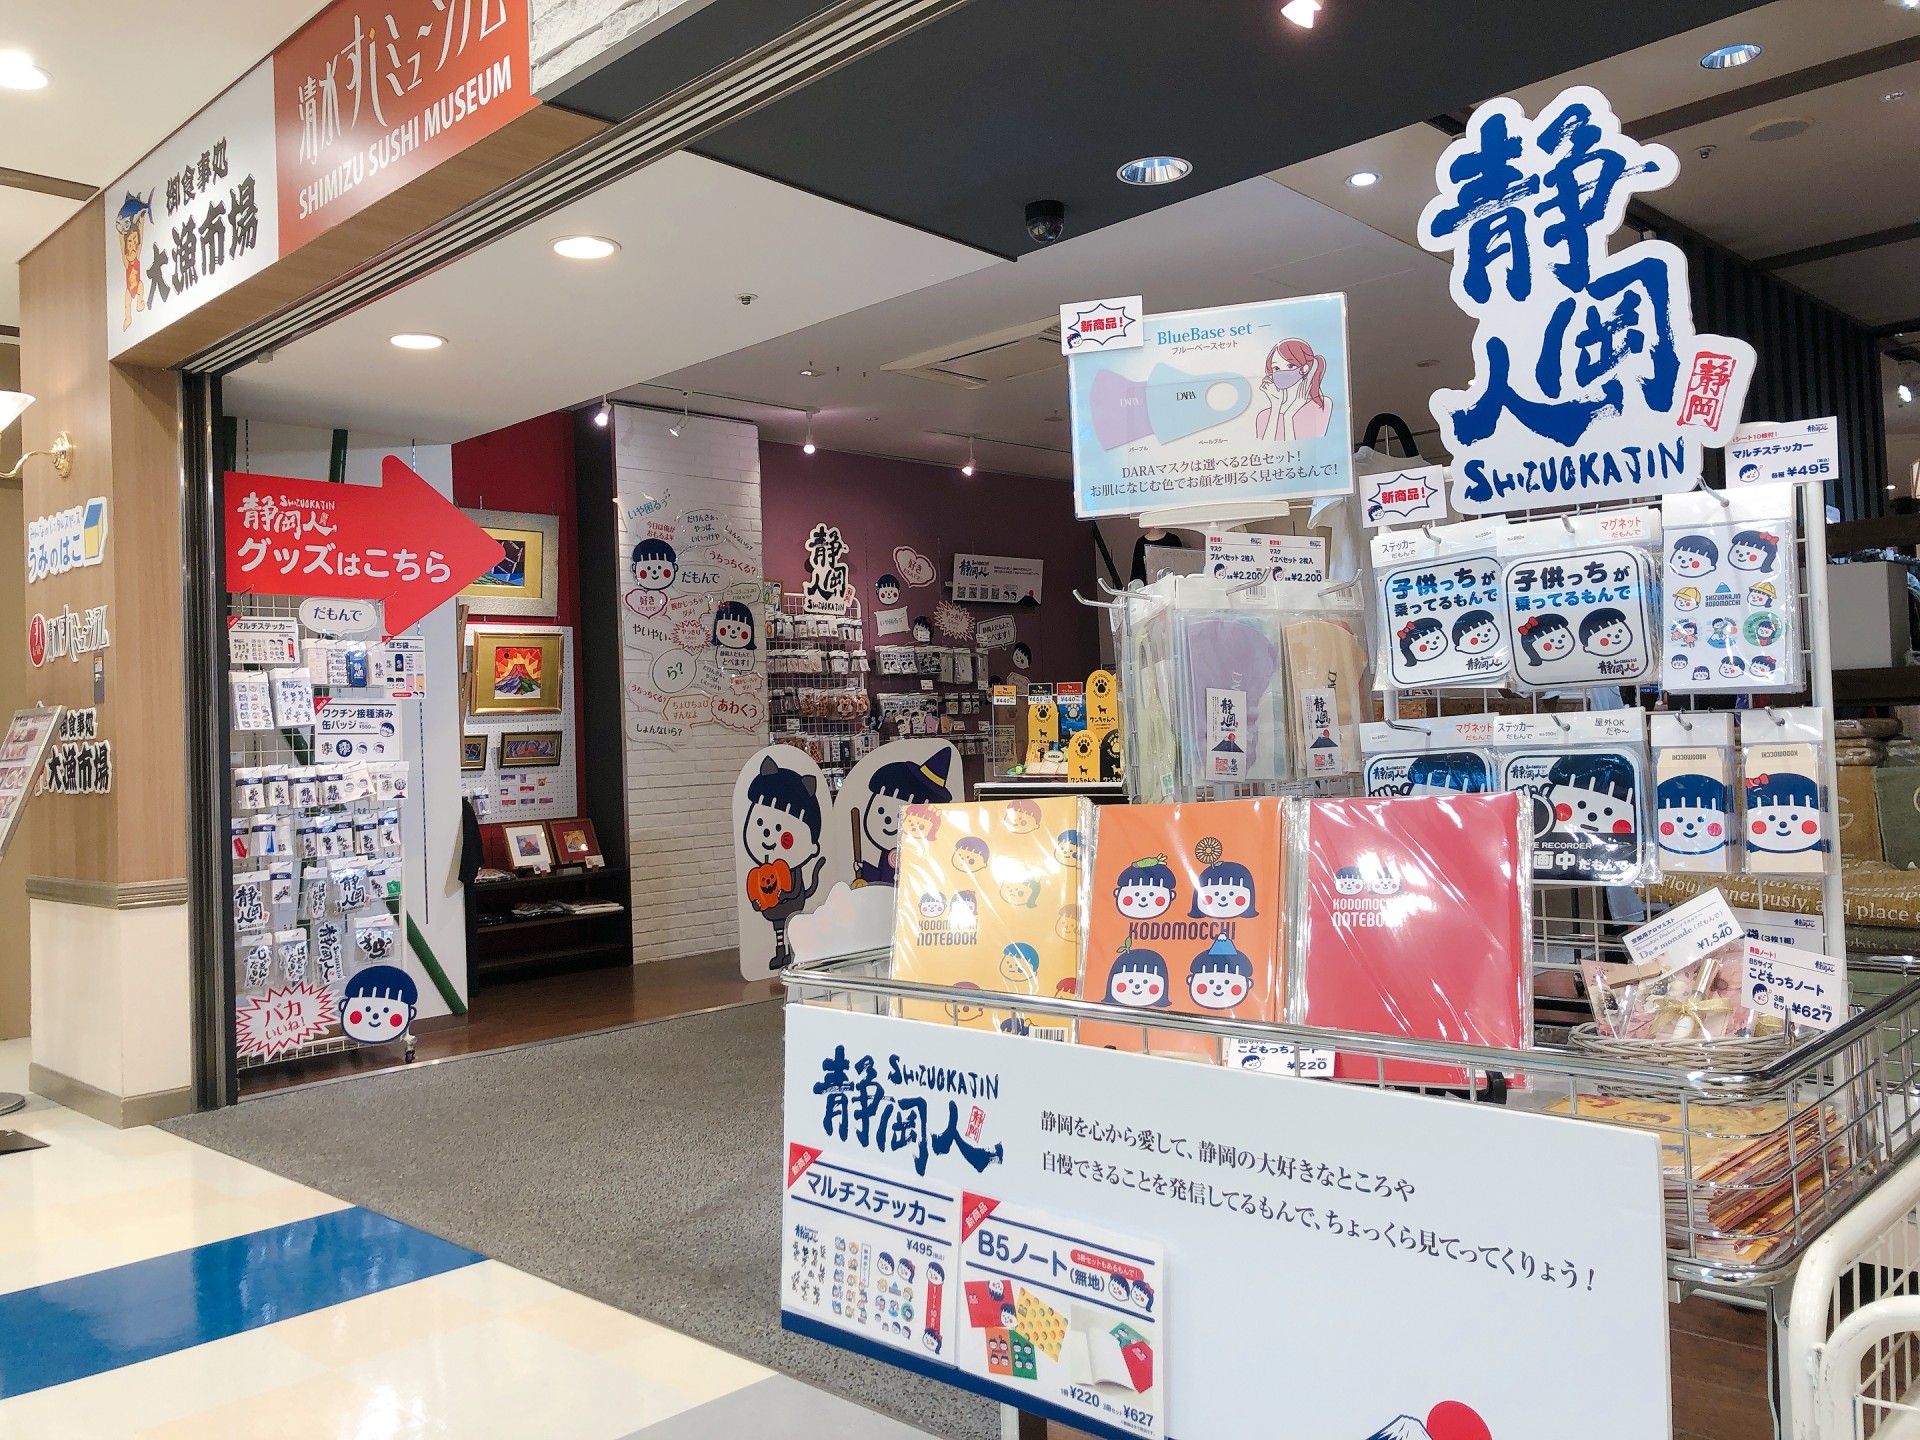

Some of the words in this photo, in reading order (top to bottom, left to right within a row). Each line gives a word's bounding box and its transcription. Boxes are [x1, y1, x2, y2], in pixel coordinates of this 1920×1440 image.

[300, 152, 364, 219] SHIMIZU
[368, 116, 419, 176] SUSHI
[424, 55, 511, 142] MUSEUM
[146, 173, 259, 311] 大漁市場
[1431, 104, 1680, 447] 静岡人
[1081, 317, 1124, 333] 新商品！
[1157, 326, 1225, 346] BlueBase
[1230, 323, 1252, 336] set
[1171, 340, 1239, 355] ブルーベースセット
[1176, 391, 1197, 401] DARA
[1198, 438, 1229, 446] ペールブルー
[1732, 442, 1814, 459] マルチステッカー
[1122, 450, 1302, 479] DARAマスクは選べる2色セット！
[1464, 436, 1685, 501] SHIZUOKAJIN
[1787, 464, 1830, 478] ¥495
[1090, 464, 1339, 497] お肌になじむ色でお顔を明るく見せるもんで！
[280, 495, 335, 511] SHIZUOKAJIN
[1381, 487, 1427, 504] 新商品！
[237, 491, 338, 541] 静岡人
[1600, 516, 1641, 531] マグネット
[1611, 529, 1641, 539] だもんで
[29, 533, 82, 577] うみのはこ
[1381, 539, 1416, 553] ステッカー
[238, 537, 451, 583] グッズはこちら
[709, 551, 757, 576] うちっちくる？
[1210, 553, 1239, 561] ブルベセット
[1269, 556, 1297, 564] イエベセット
[681, 571, 720, 584] だもんで
[1392, 568, 1496, 600] 子供っちが
[1513, 560, 1630, 592] 子供っちが
[640, 595, 656, 606] 好き
[1394, 589, 1499, 617] 乗ってるもんで
[1515, 585, 1631, 612] 乗ってるもんで
[313, 606, 363, 622] だもんで
[236, 622, 293, 631] マルチステッカー
[666, 661, 684, 681] ら？
[321, 708, 394, 719] ワクチン接種済み
[717, 698, 758, 718] あわくう
[321, 720, 357, 730] 缶バッジ
[636, 723, 683, 737] しょんないら？
[1455, 722, 1493, 734] マグネット
[1497, 722, 1534, 733] ステッカー
[1594, 717, 1625, 728] 屋外OK
[1465, 733, 1492, 741] だもんで
[1761, 750, 1799, 758] KODOMOCCHI
[48, 743, 110, 793] 大漁市場
[1333, 912, 1385, 927] NOTEBO
[1857, 904, 1909, 922] place
[917, 932, 977, 946] NOTEBOOK
[1129, 921, 1236, 940] KODOMOCCHI
[1696, 926, 1733, 950] ¥1,540
[1749, 957, 1774, 970] B5サイズ
[1749, 967, 1825, 997] こどもっちノート
[265, 1000, 301, 1027] バカ
[1774, 1002, 1785, 1011] セッ
[1791, 1002, 1833, 1024] ¥627
[266, 1018, 306, 1040] いいね！
[1287, 1061, 1327, 1070] ¥220
[888, 1054, 1000, 1100] SHIZUOKAJIN
[813, 1045, 1004, 1176] 静岡人
[791, 1150, 812, 1176] 新商品
[1040, 1110, 1416, 1202] 静岡を心から愛して、静岡の大好きなところや
[806, 1171, 946, 1226] マルチステッカー
[965, 1201, 989, 1228] 新商品
[1041, 1150, 1596, 1292] 自慢できることを発信してるもんで、ちょっくら見てってくりょう！
[906, 1238, 933, 1257] ¥495
[978, 1229, 1068, 1277] B5ノート
[1069, 1267, 1106, 1293] (無地)
[1076, 1252, 1139, 1279] 3冊セットもあるもんで！
[1069, 1385, 1100, 1408] ¥220
[1123, 1404, 1154, 1428] ¥627
